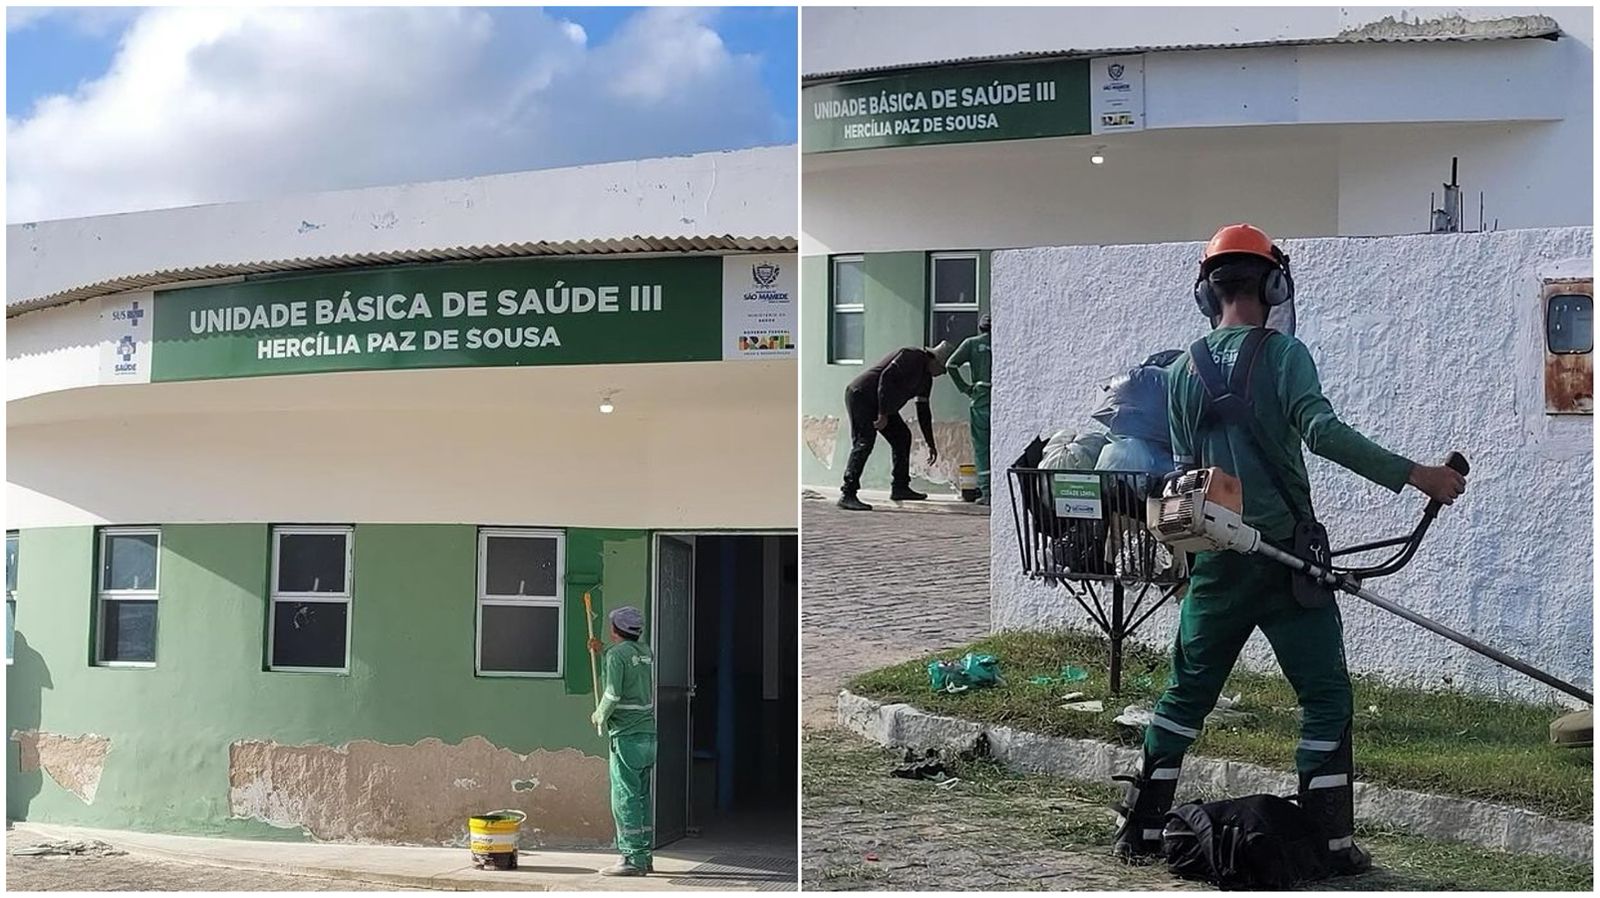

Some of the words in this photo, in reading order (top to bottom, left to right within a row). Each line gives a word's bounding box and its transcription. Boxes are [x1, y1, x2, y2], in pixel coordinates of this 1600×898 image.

[814, 97, 867, 120] UNIDADE
[869, 90, 928, 115] BÁSICA
[932, 87, 959, 109] DE
[961, 80, 1031, 106] SAÚDE
[1036, 81, 1056, 101] III
[844, 119, 893, 138] HERCÍLIA
[895, 118, 920, 135] PAZ
[923, 117, 943, 132] DE
[945, 113, 999, 131] SOUSA
[112, 310, 127, 320] SUS
[190, 301, 308, 334] UNIDADE
[315, 290, 433, 325] BÁSICA
[442, 290, 488, 317] DE
[497, 280, 619, 315] SAÚDE
[630, 285, 662, 311] III
[257, 331, 361, 359] HERCÍLIA
[367, 331, 417, 353] PAZ
[424, 329, 459, 350] DE
[466, 326, 561, 349] SOUSA
